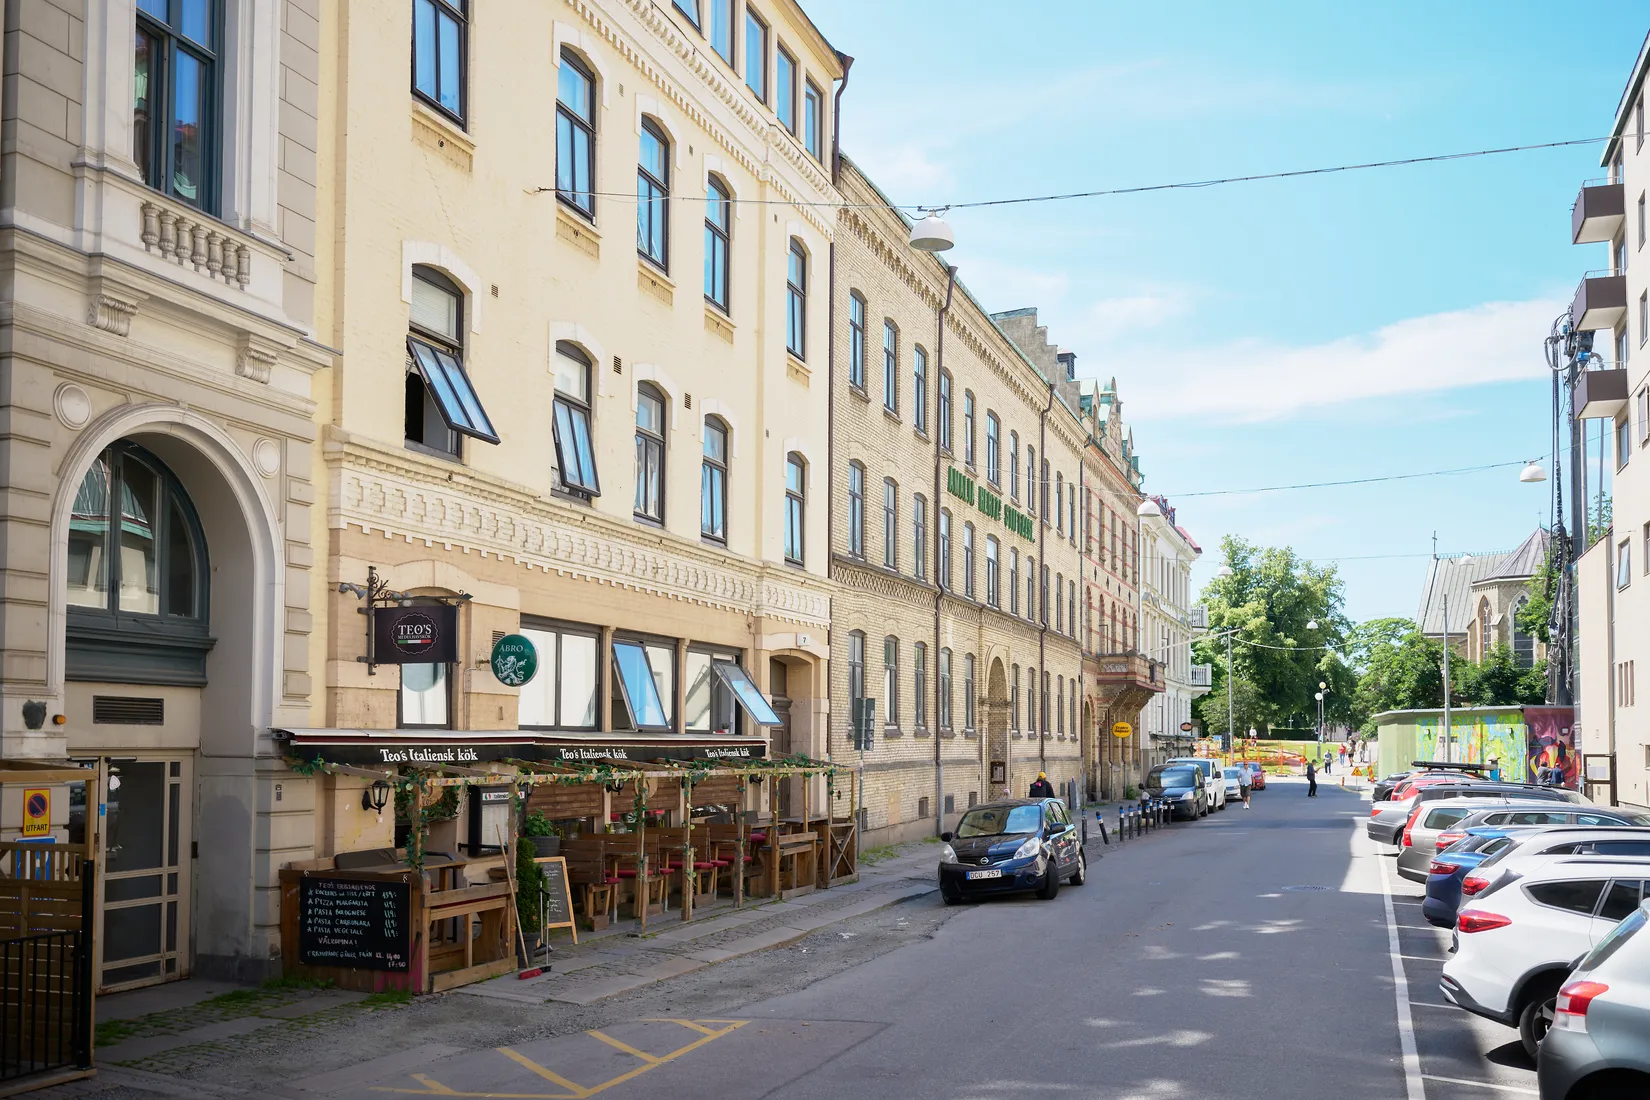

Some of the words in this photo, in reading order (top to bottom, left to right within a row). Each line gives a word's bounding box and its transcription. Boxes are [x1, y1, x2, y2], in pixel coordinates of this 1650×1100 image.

[397, 624, 432, 635] TEO'S
[380, 748, 408, 762] Teo's
[408, 748, 455, 761] Italiensk
[457, 748, 479, 761] kök
[560, 748, 579, 760] Teo's
[580, 749, 612, 759] Italiensk
[612, 749, 628, 760] kök
[705, 749, 718, 758] Teo's
[740, 748, 750, 757] kök
[26, 824, 48, 832] UTFART
[314, 897, 334, 906] PIZZA
[314, 908, 333, 916] PASTA
[335, 908, 367, 916] BOLOGNESE
[313, 917, 332, 925] PASTA
[335, 918, 371, 927] CARBONARA
[313, 926, 331, 934] PASTA
